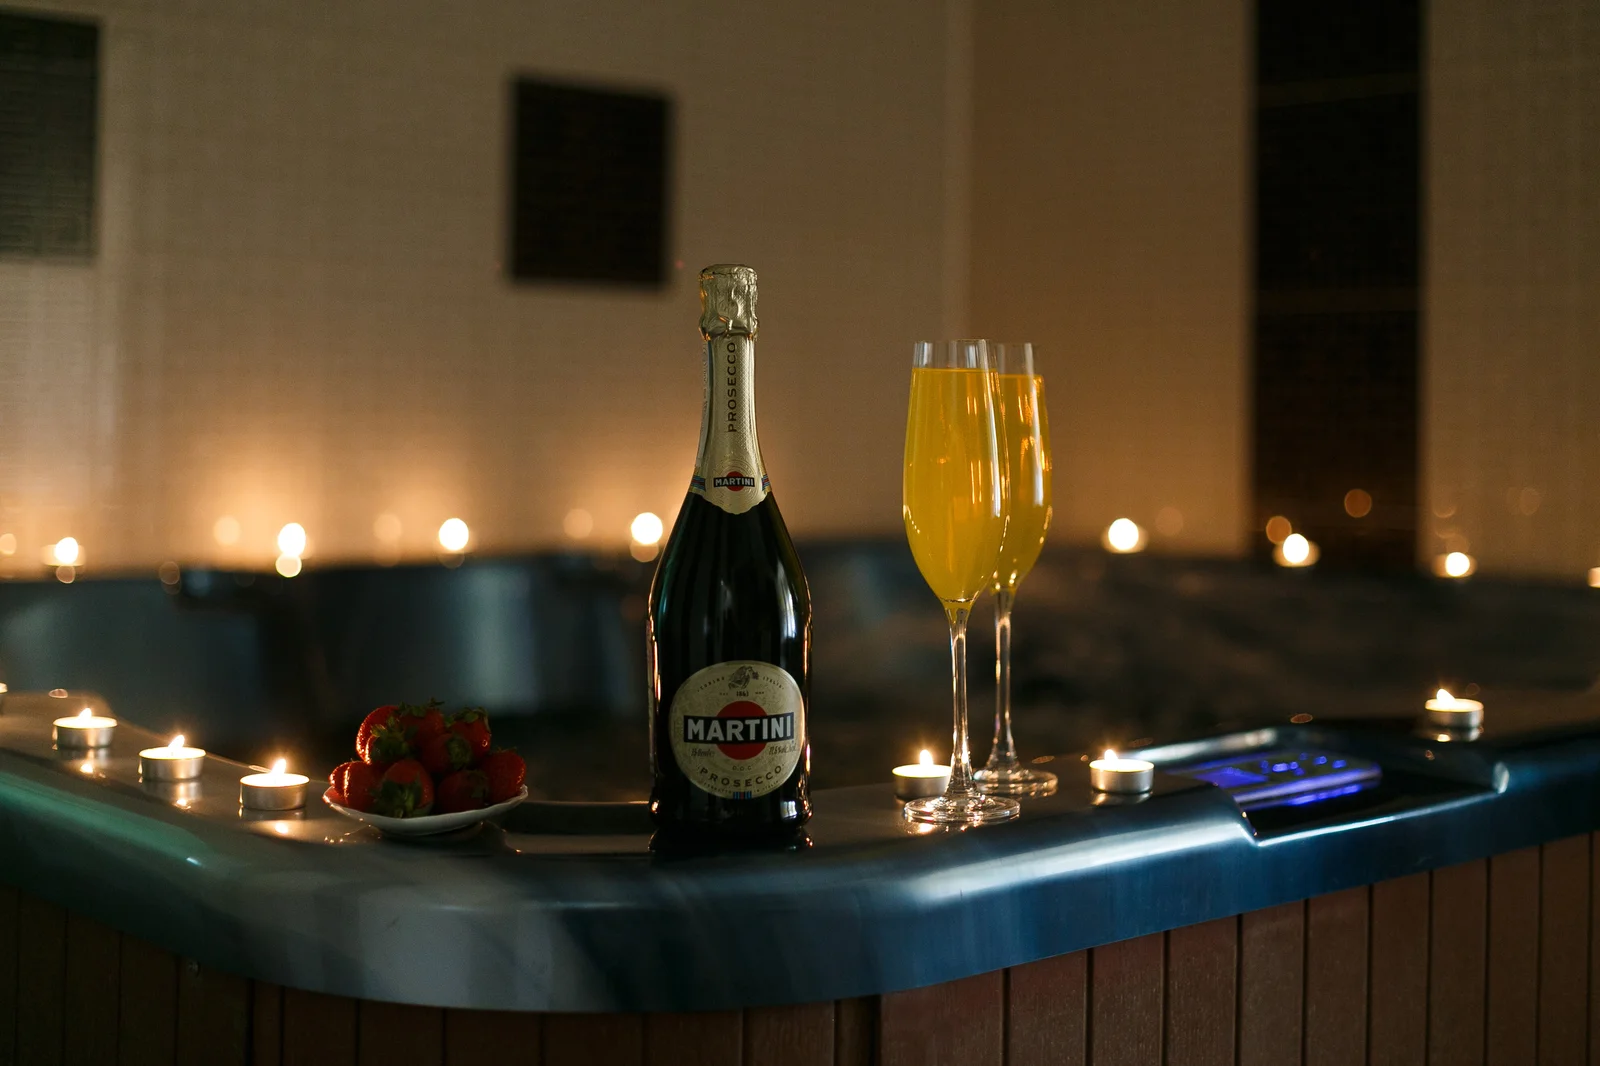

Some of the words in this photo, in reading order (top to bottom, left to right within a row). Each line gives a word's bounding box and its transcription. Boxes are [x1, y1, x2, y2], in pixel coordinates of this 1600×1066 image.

[726, 342, 737, 433] PROSECCO
[715, 477, 754, 486] MARTINI
[687, 715, 792, 741] MARTINI
[700, 765, 782, 788] PROSECCO
